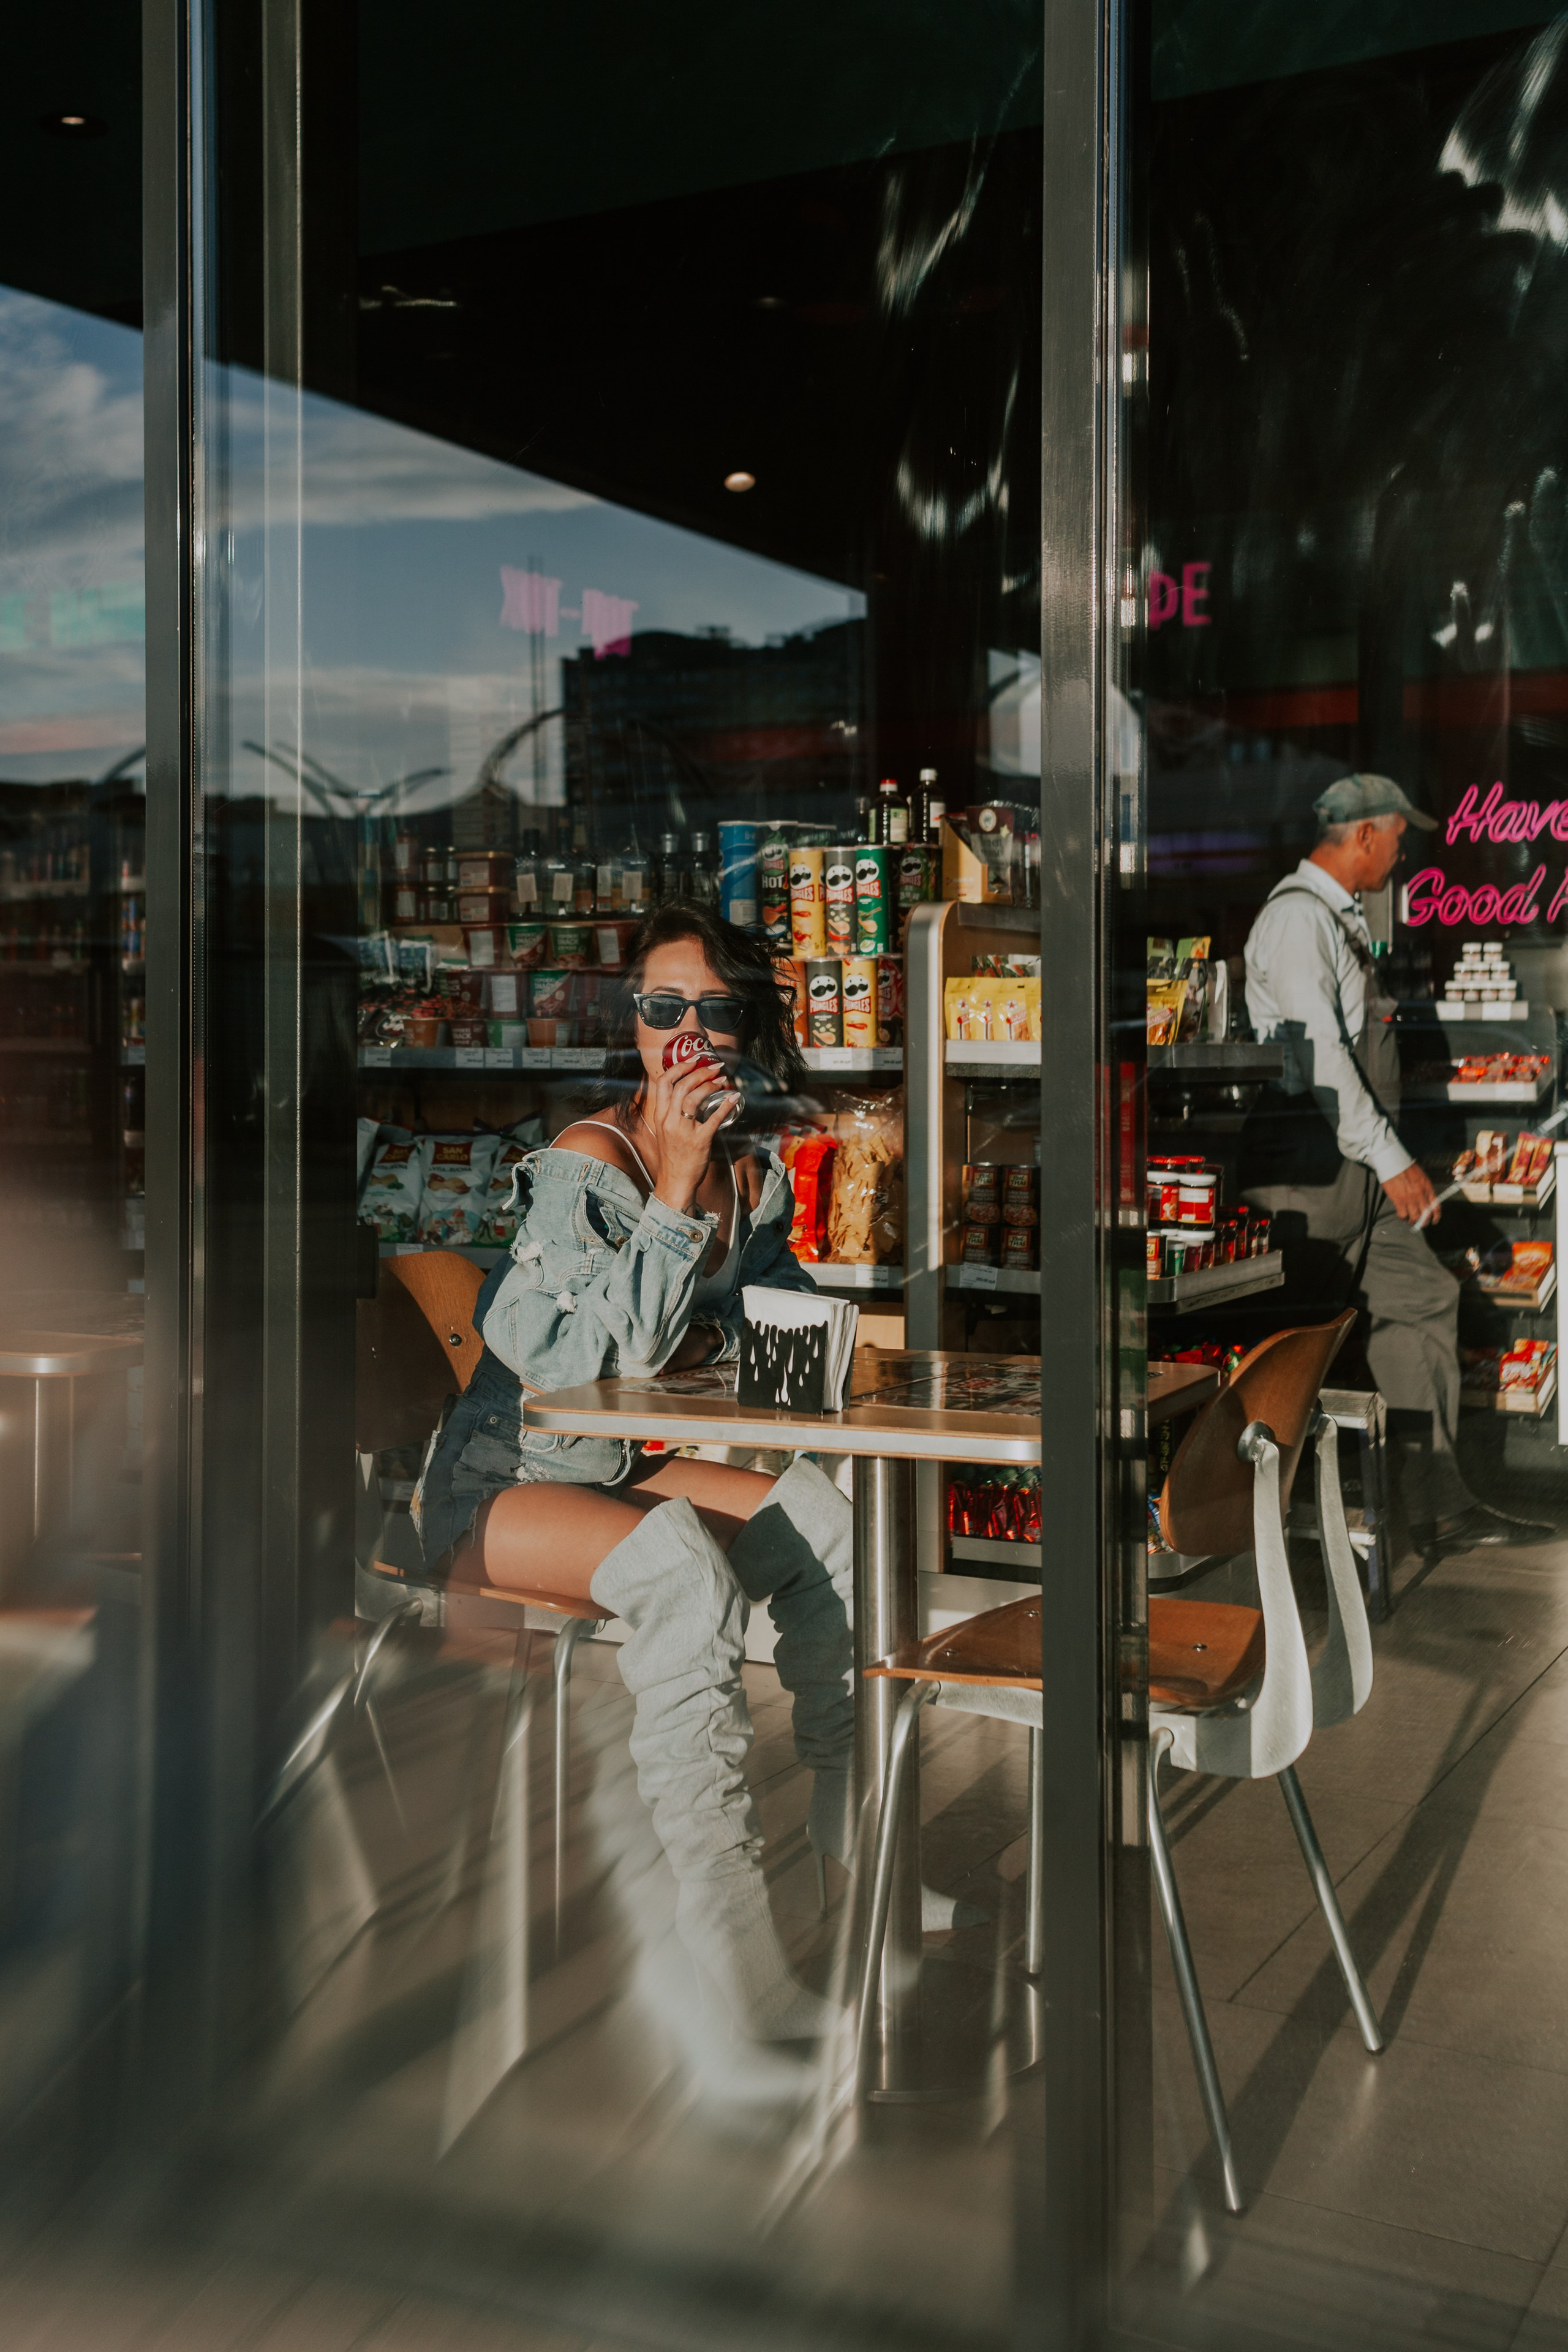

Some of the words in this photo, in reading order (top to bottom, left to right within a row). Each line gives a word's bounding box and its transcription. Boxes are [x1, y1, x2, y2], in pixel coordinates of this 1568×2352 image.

[761, 874, 785, 889] HOT
[1407, 863, 1547, 927] Good
[810, 998, 839, 1014] PRINGLES
[843, 997, 870, 1013] PRINGLES
